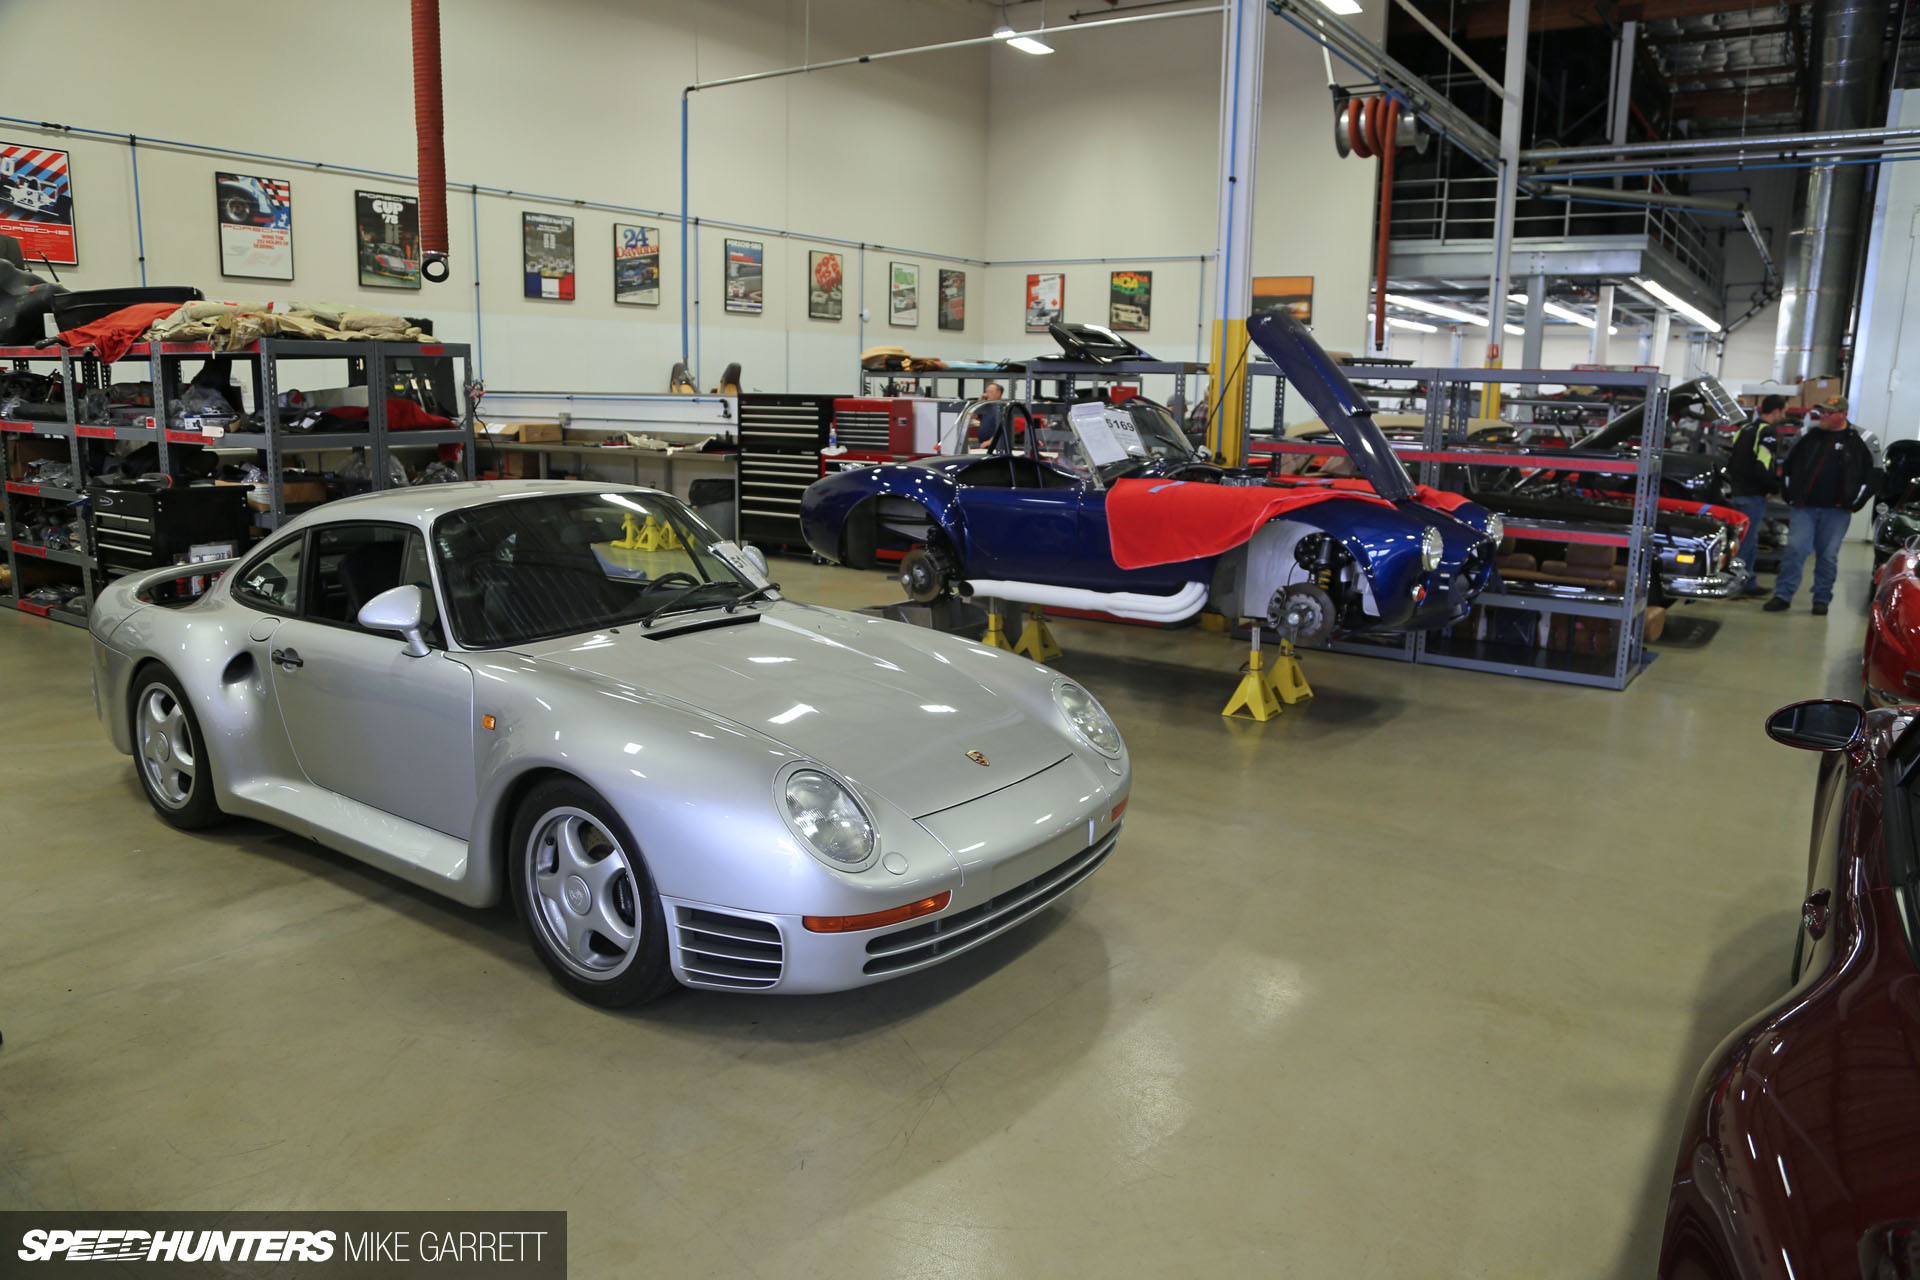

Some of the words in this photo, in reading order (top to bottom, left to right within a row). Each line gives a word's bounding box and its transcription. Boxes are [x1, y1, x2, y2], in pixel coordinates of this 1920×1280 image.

[359, 192, 417, 204] PORSCHE
[372, 199, 404, 215] CUP
[0, 225, 69, 236] ORSCHE
[624, 226, 650, 249] 24
[616, 245, 659, 260] Daytona
[1105, 418, 1135, 432] 5169
